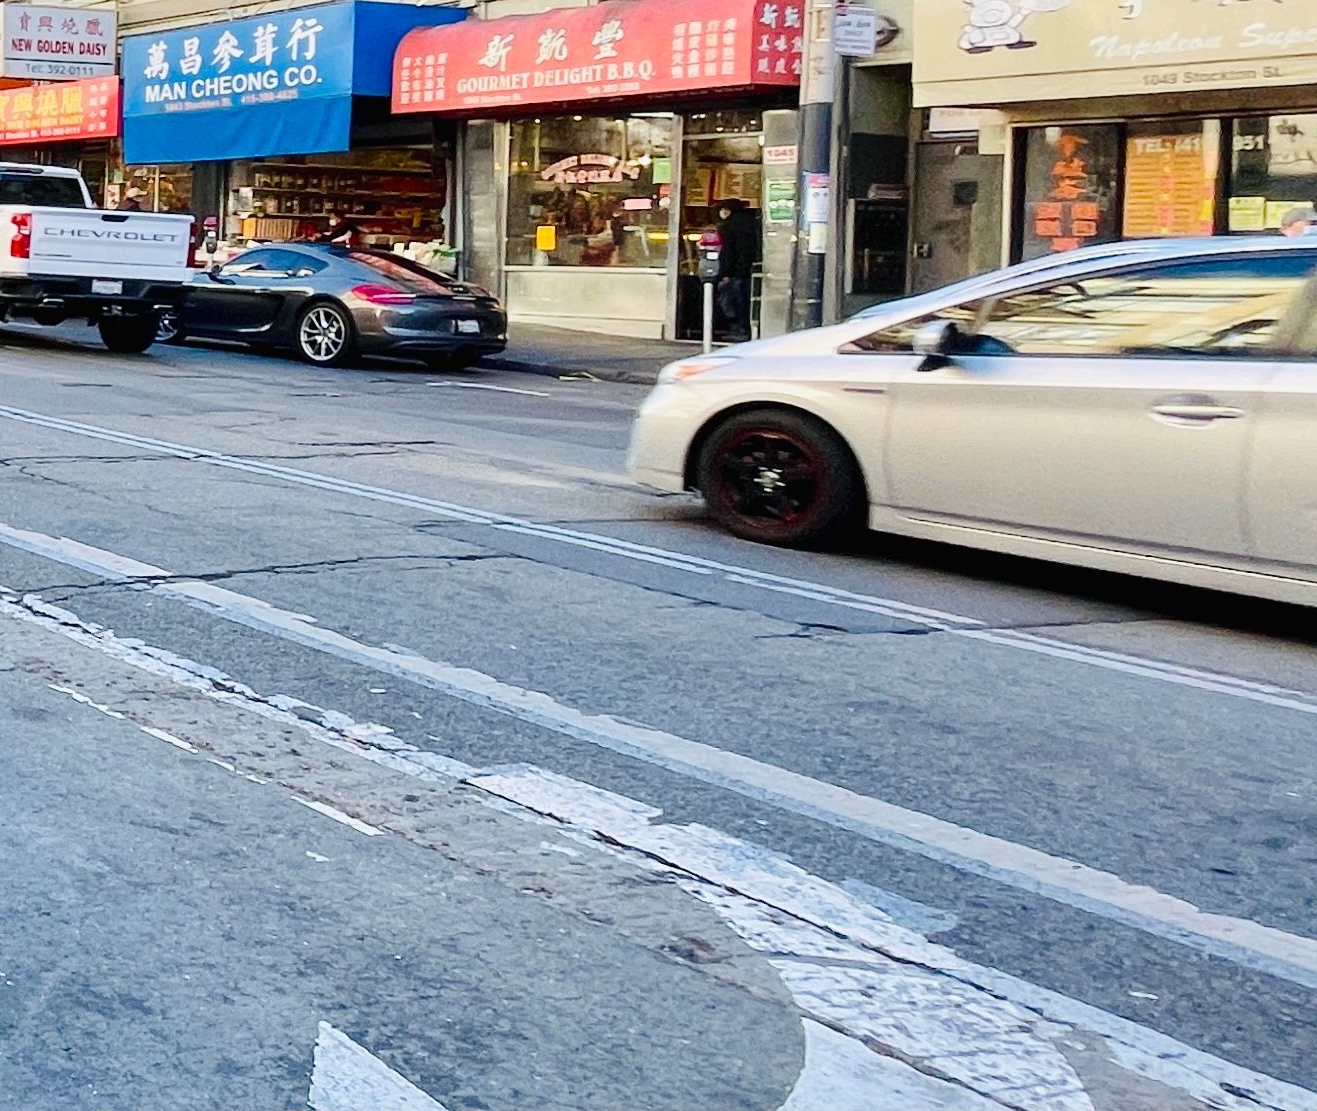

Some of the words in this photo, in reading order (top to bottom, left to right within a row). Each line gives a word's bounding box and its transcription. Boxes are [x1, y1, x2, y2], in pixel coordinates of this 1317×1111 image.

[11, 38, 32, 52] NEW
[37, 40, 74, 55] GOLDEN
[79, 42, 107, 56] DAISY
[1089, 31, 1223, 60] Napoleon
[145, 81, 187, 103] MAN
[191, 69, 279, 98] CHEONG
[284, 64, 323, 87] CO.
[457, 72, 530, 95] GOURMET
[533, 64, 605, 89] DELIGHT
[607, 60, 657, 82] B.B.Q.
[1183, 68, 1257, 84] Stockton
[44, 227, 179, 242] CHEVROLET
